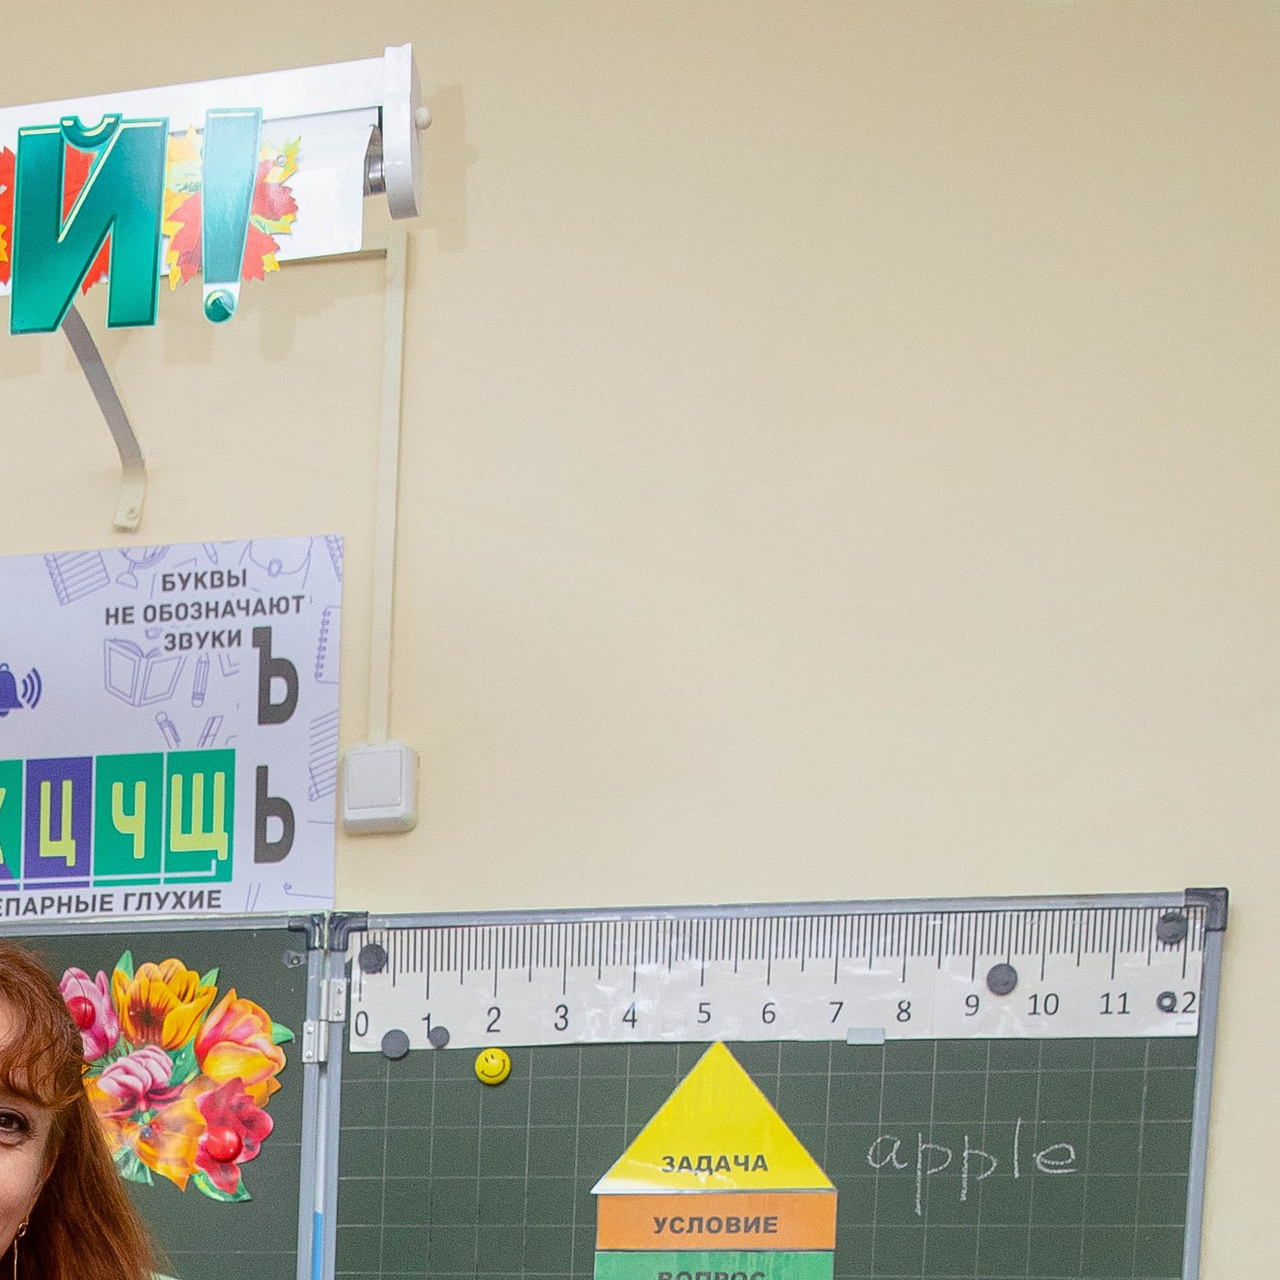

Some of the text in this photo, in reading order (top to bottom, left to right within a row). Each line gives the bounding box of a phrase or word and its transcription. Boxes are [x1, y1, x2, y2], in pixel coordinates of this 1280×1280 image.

[161, 568, 247, 593] БУКВЫ
[104, 594, 306, 626] НЕ ОБОЗНАЧАЮТ
[163, 629, 242, 652] ЗВУКИ
[251, 625, 300, 726] Ъ
[39, 779, 76, 867] Ц
[111, 780, 147, 860] Ч
[169, 771, 229, 862] Щ
[253, 765, 296, 864] Ь
[123, 889, 222, 912] ГЛУХИЕ
[354, 1011, 369, 1037] 0
[421, 1013, 432, 1039] 1
[486, 1006, 501, 1033] 2
[554, 1004, 569, 1032] 3
[622, 1002, 638, 1029] 4
[697, 1002, 711, 1025] 5
[761, 1002, 776, 1024] 6
[829, 1001, 844, 1024] 7
[896, 999, 912, 1022] 8
[964, 994, 979, 1016] 9
[1027, 993, 1060, 1016] 10
[1099, 991, 1131, 1015] 11
[662, 1154, 769, 1175] ЗАДАЧА
[866, 1117, 1078, 1216] apple
[653, 1216, 779, 1235] УСЛОВИЕ
